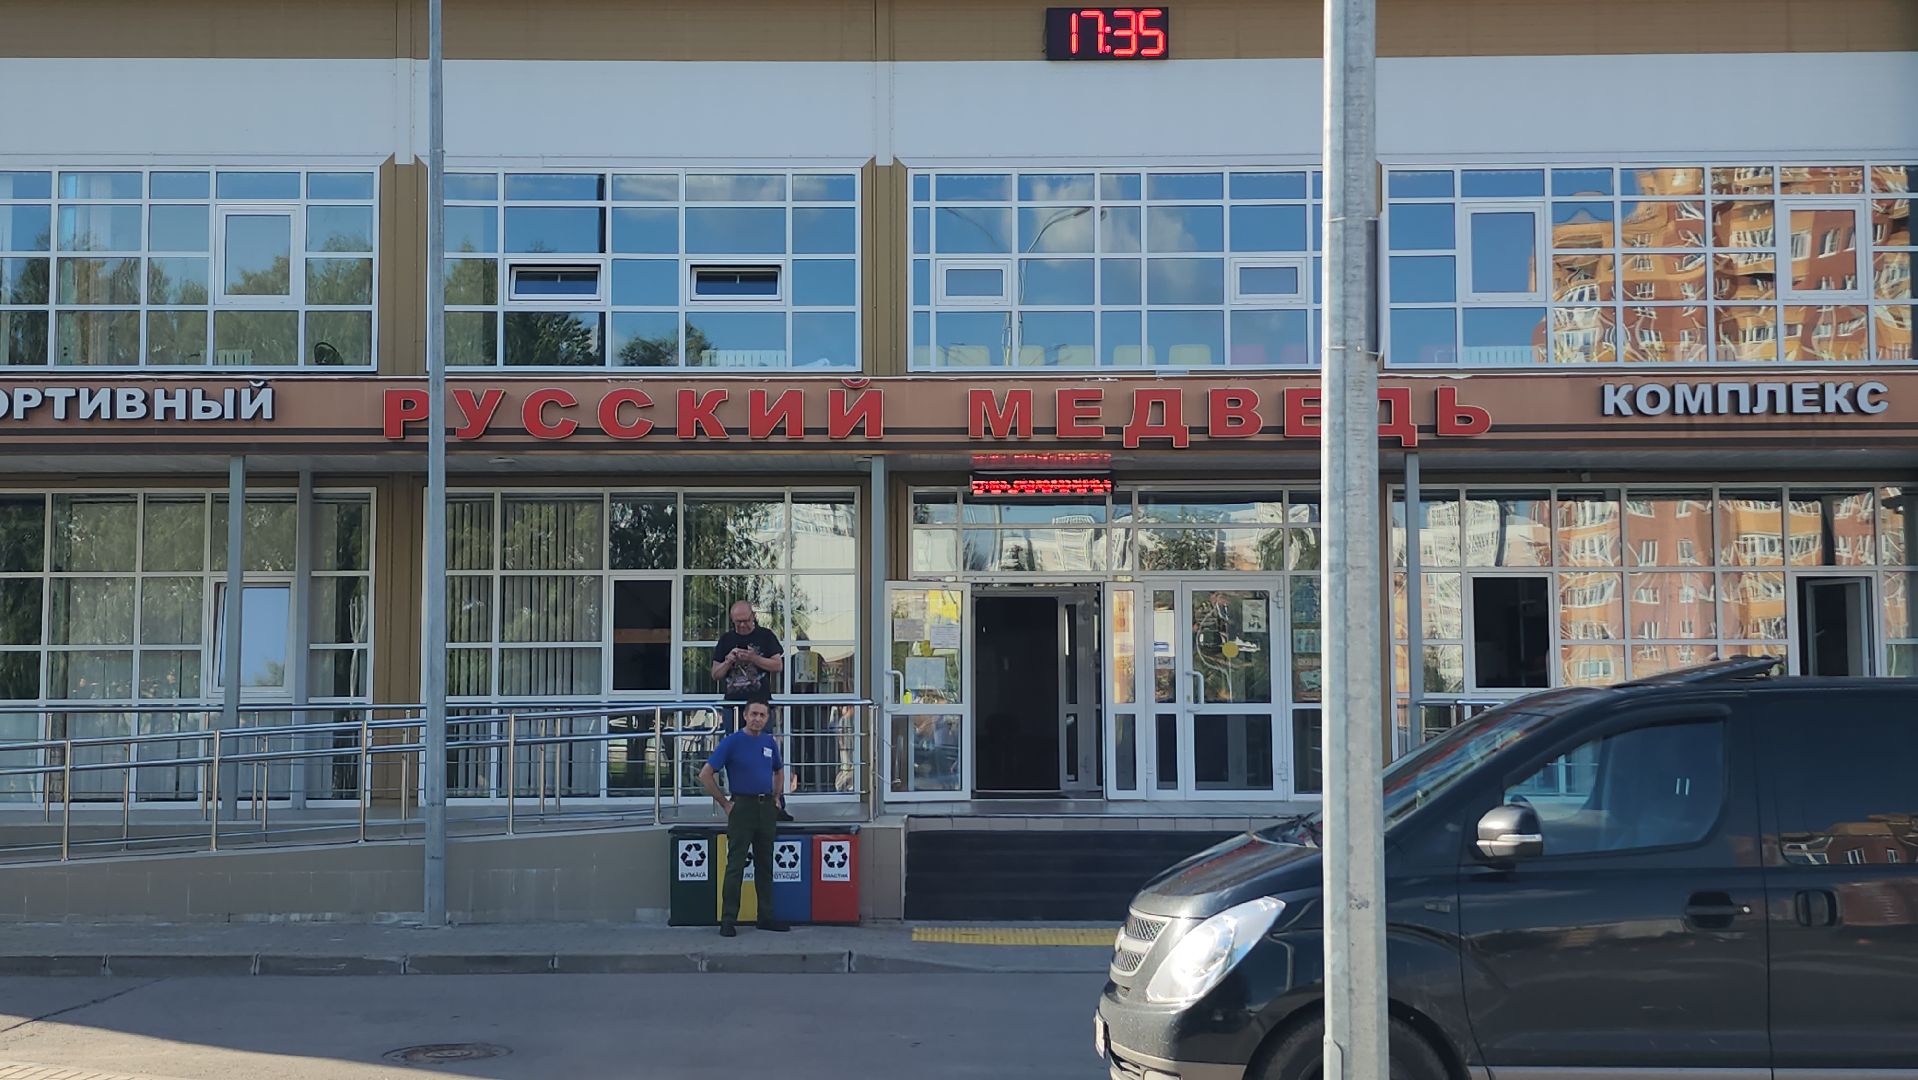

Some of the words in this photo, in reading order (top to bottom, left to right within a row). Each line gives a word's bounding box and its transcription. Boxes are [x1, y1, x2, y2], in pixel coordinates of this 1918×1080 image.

[1070, 9, 1165, 57] 17:35
[0, 379, 274, 420] РТИВНЫЙ
[383, 377, 885, 440] РУССКИЙ
[968, 385, 1492, 449] МЕДВЕДЬ
[1602, 380, 1889, 415] КОМПЛЕКС
